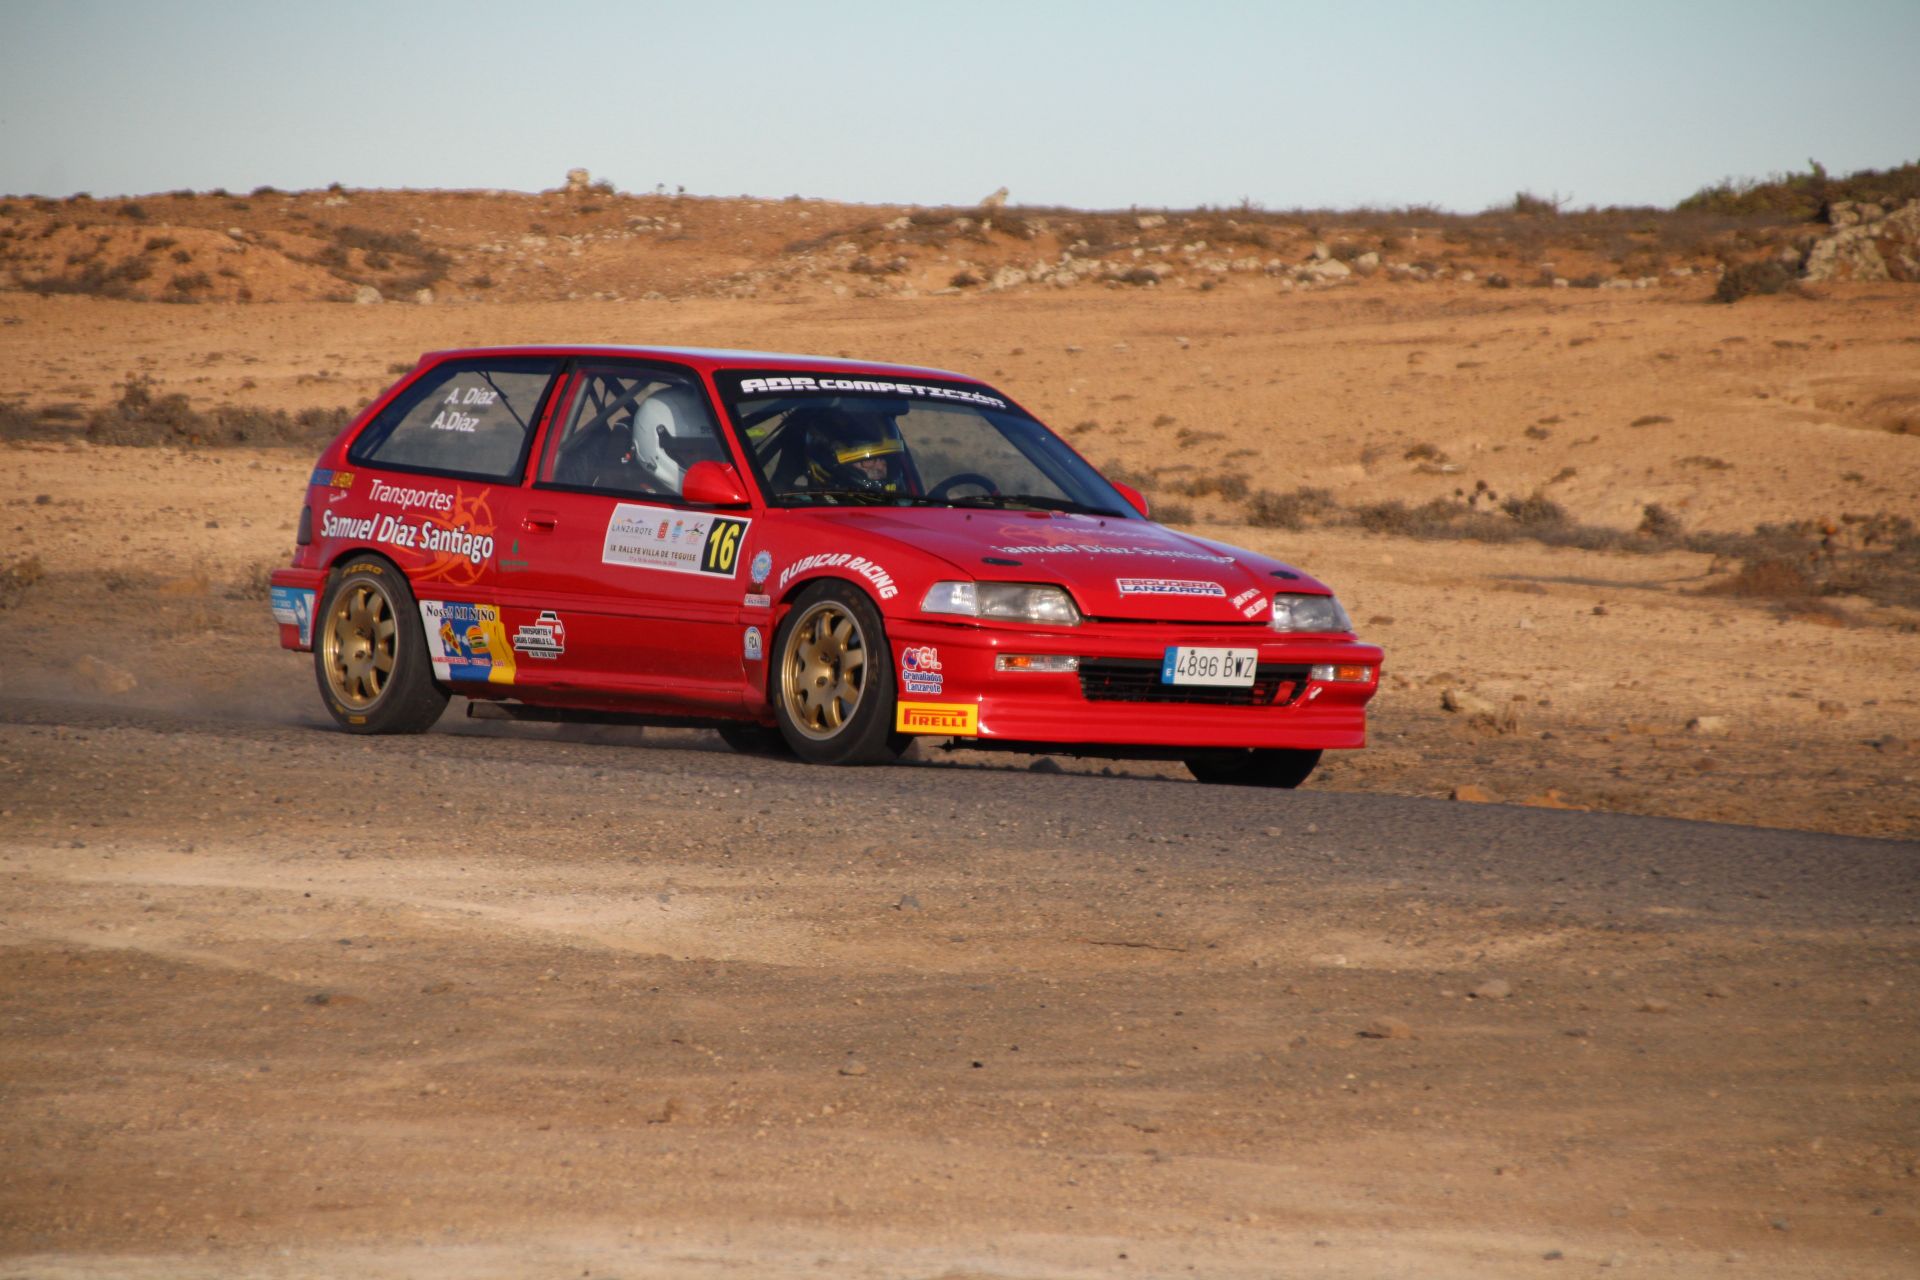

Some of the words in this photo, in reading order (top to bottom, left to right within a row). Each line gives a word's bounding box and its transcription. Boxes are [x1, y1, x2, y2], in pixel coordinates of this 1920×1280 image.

[463, 387, 498, 405] Díaz
[368, 479, 454, 511] Transportes
[320, 509, 380, 541] Samuel
[377, 516, 418, 548] Díaz
[419, 521, 494, 564] Santiago
[611, 525, 653, 536] LANZAROTE
[618, 544, 641, 555] RALLYE
[642, 548, 659, 557] VILLA
[660, 550, 668, 558] DE
[671, 552, 697, 562] TEGUISE
[709, 521, 740, 570] 16
[844, 556, 898, 599] RACING
[1120, 579, 1221, 589] ESCUDERIA
[1121, 585, 1223, 595] LANZAROTE
[455, 606, 467, 619] MI
[469, 606, 495, 622] NIÑO
[1165, 668, 1173, 677] E
[1177, 655, 1219, 677] 4896
[1223, 656, 1255, 678] BWZ
[907, 683, 942, 694] Lanzarote
[904, 708, 968, 728] PIRELLI
